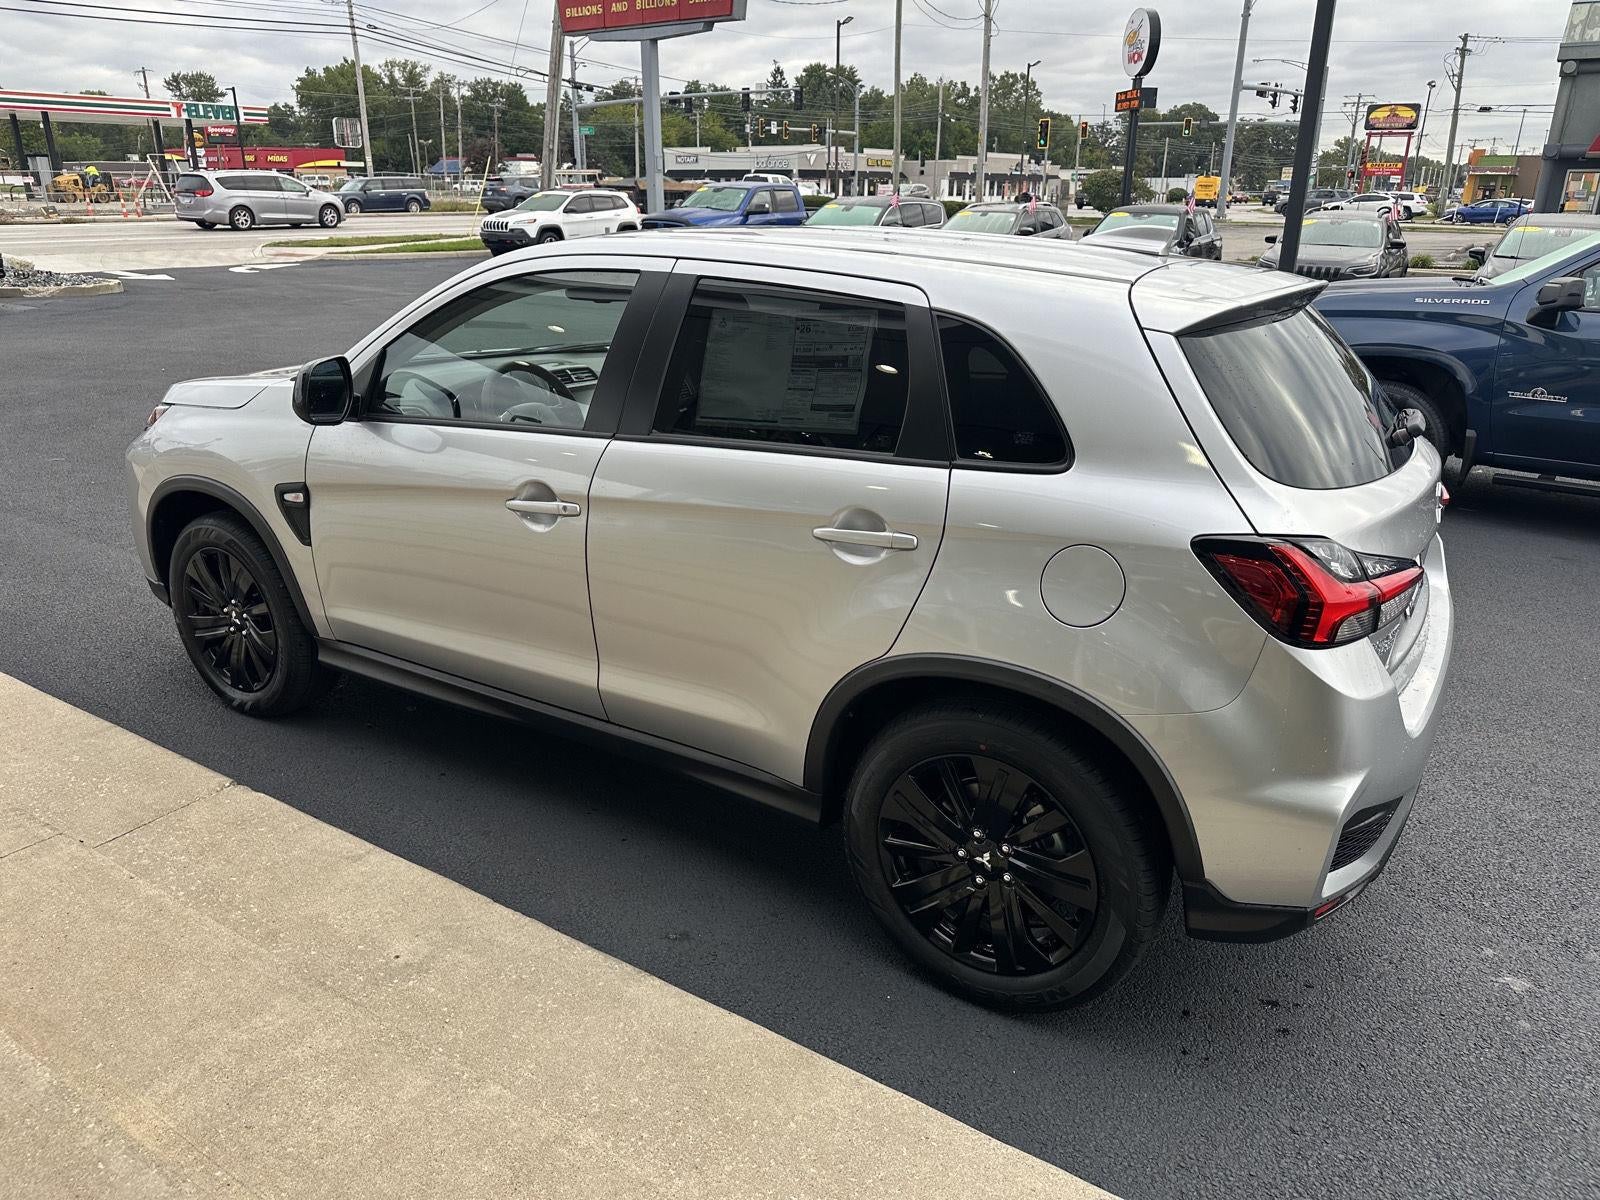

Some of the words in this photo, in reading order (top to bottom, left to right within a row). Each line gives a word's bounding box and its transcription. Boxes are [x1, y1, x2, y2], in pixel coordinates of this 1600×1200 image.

[565, 4, 603, 17] BILLIONS
[611, 1, 628, 12] AND
[636, 0, 677, 10] BILLIONS
[207, 126, 235, 134] Speedway
[267, 153, 288, 162] MIDAS
[676, 156, 697, 164] NOTARY
[1414, 297, 1491, 305] SILVERADO
